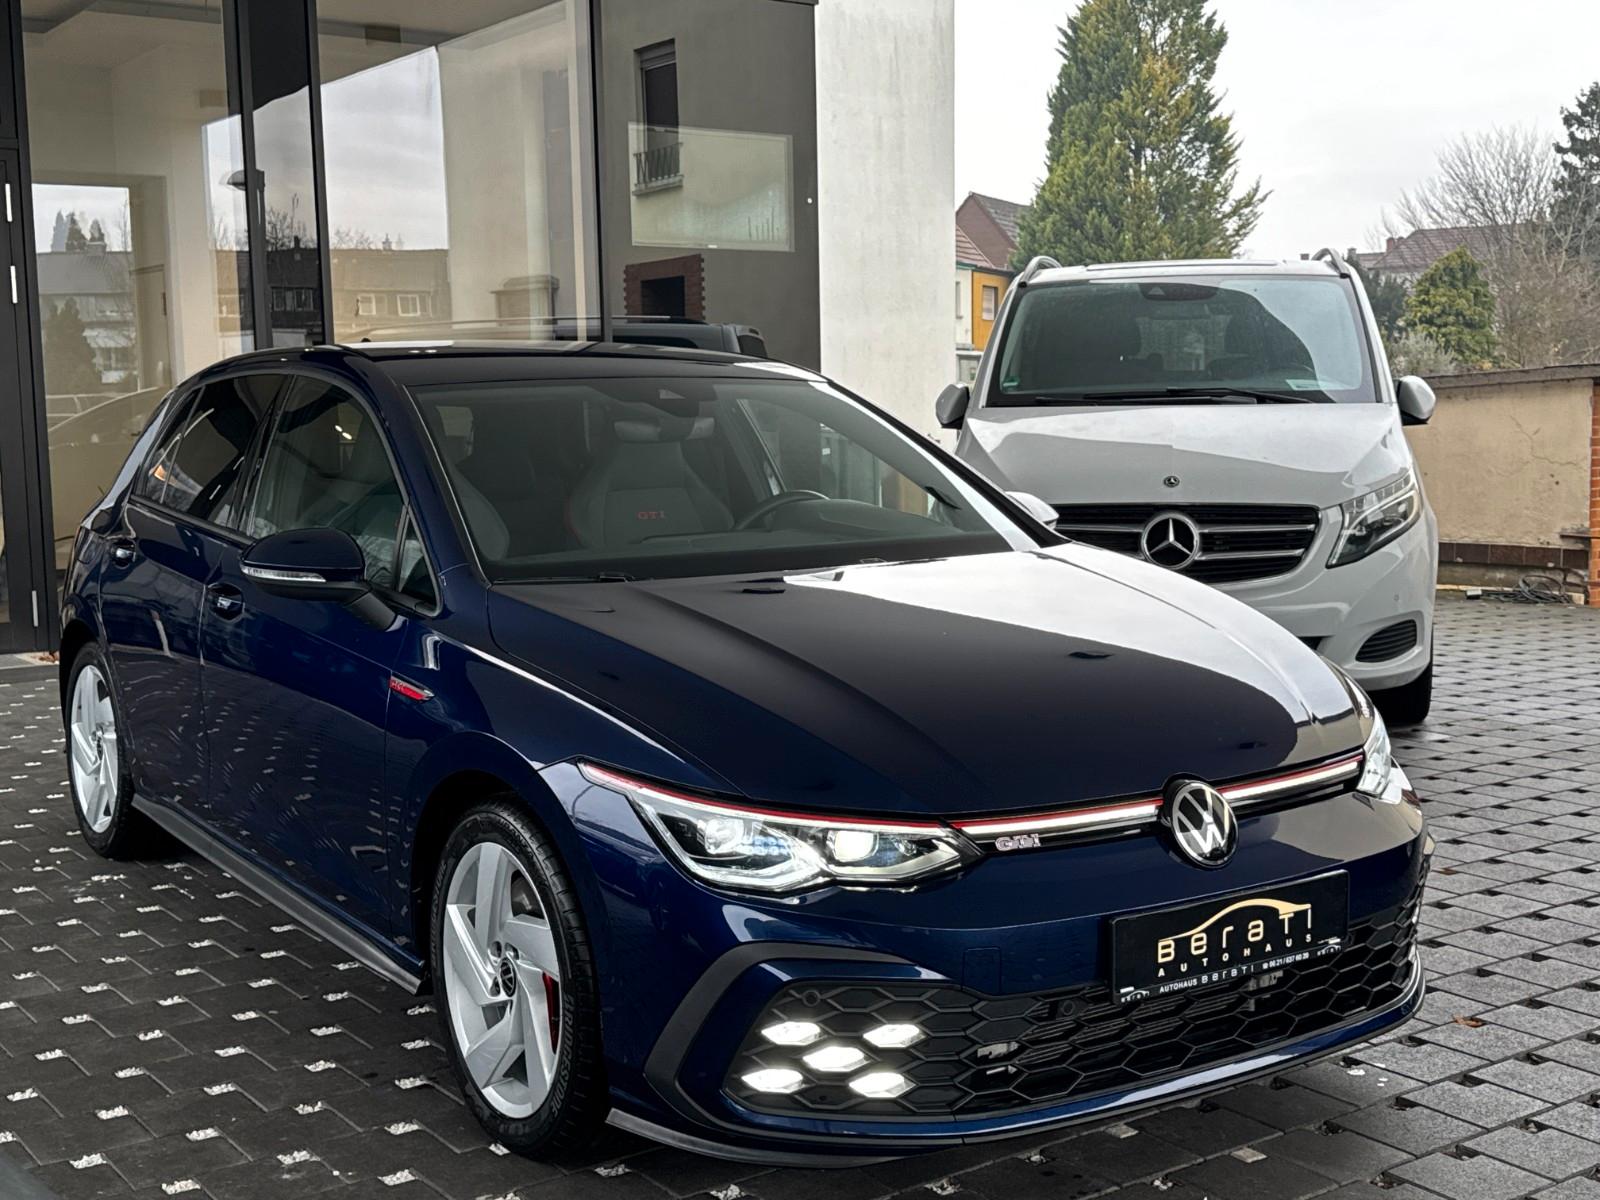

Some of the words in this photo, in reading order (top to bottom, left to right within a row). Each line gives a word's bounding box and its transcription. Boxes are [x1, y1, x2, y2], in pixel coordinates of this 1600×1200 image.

[638, 511, 665, 520] GTI
[995, 833, 1041, 851] GTI
[1158, 933, 1312, 978] AUTOHAUS
[1160, 978, 1197, 994] AUTOHAUS
